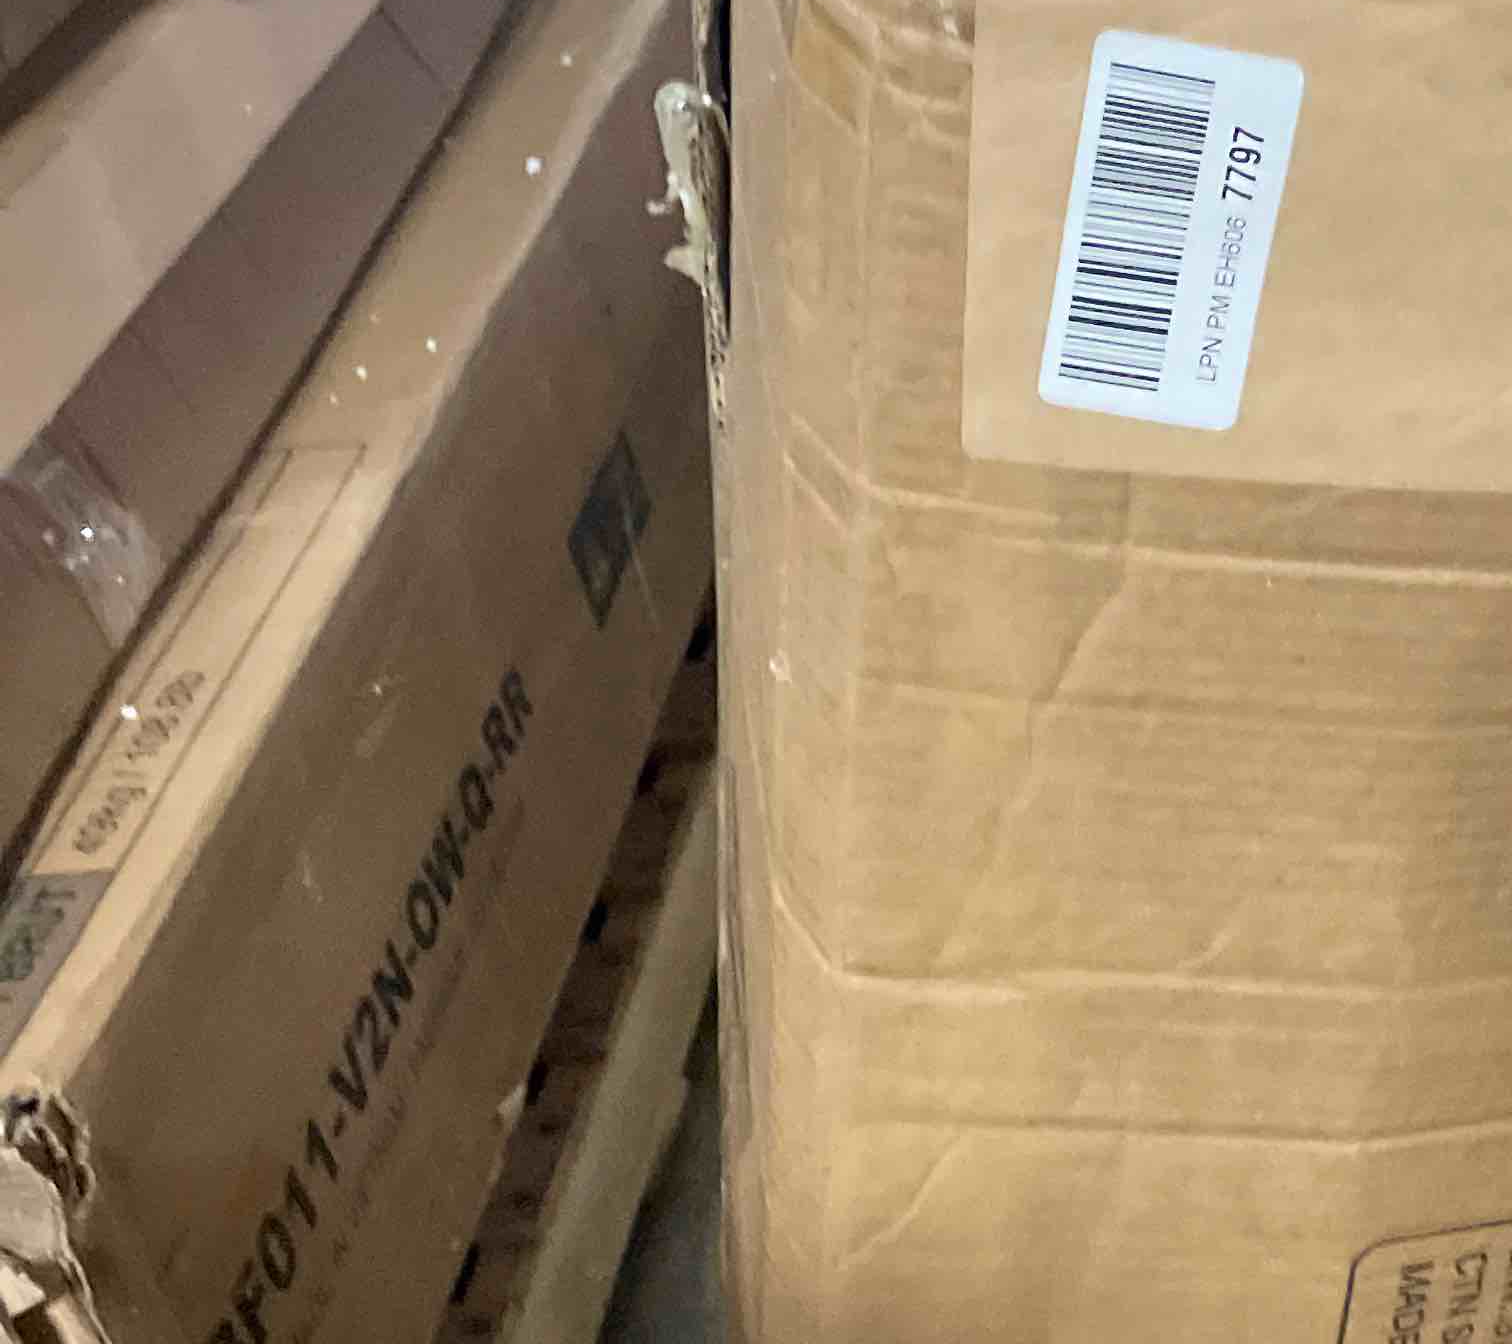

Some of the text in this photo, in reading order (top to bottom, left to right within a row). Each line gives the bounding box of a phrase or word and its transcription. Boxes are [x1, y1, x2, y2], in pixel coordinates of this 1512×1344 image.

[1195, 125, 1266, 384] LPN PM EH606 7797
[1447, 1250, 1489, 1318] CTN
